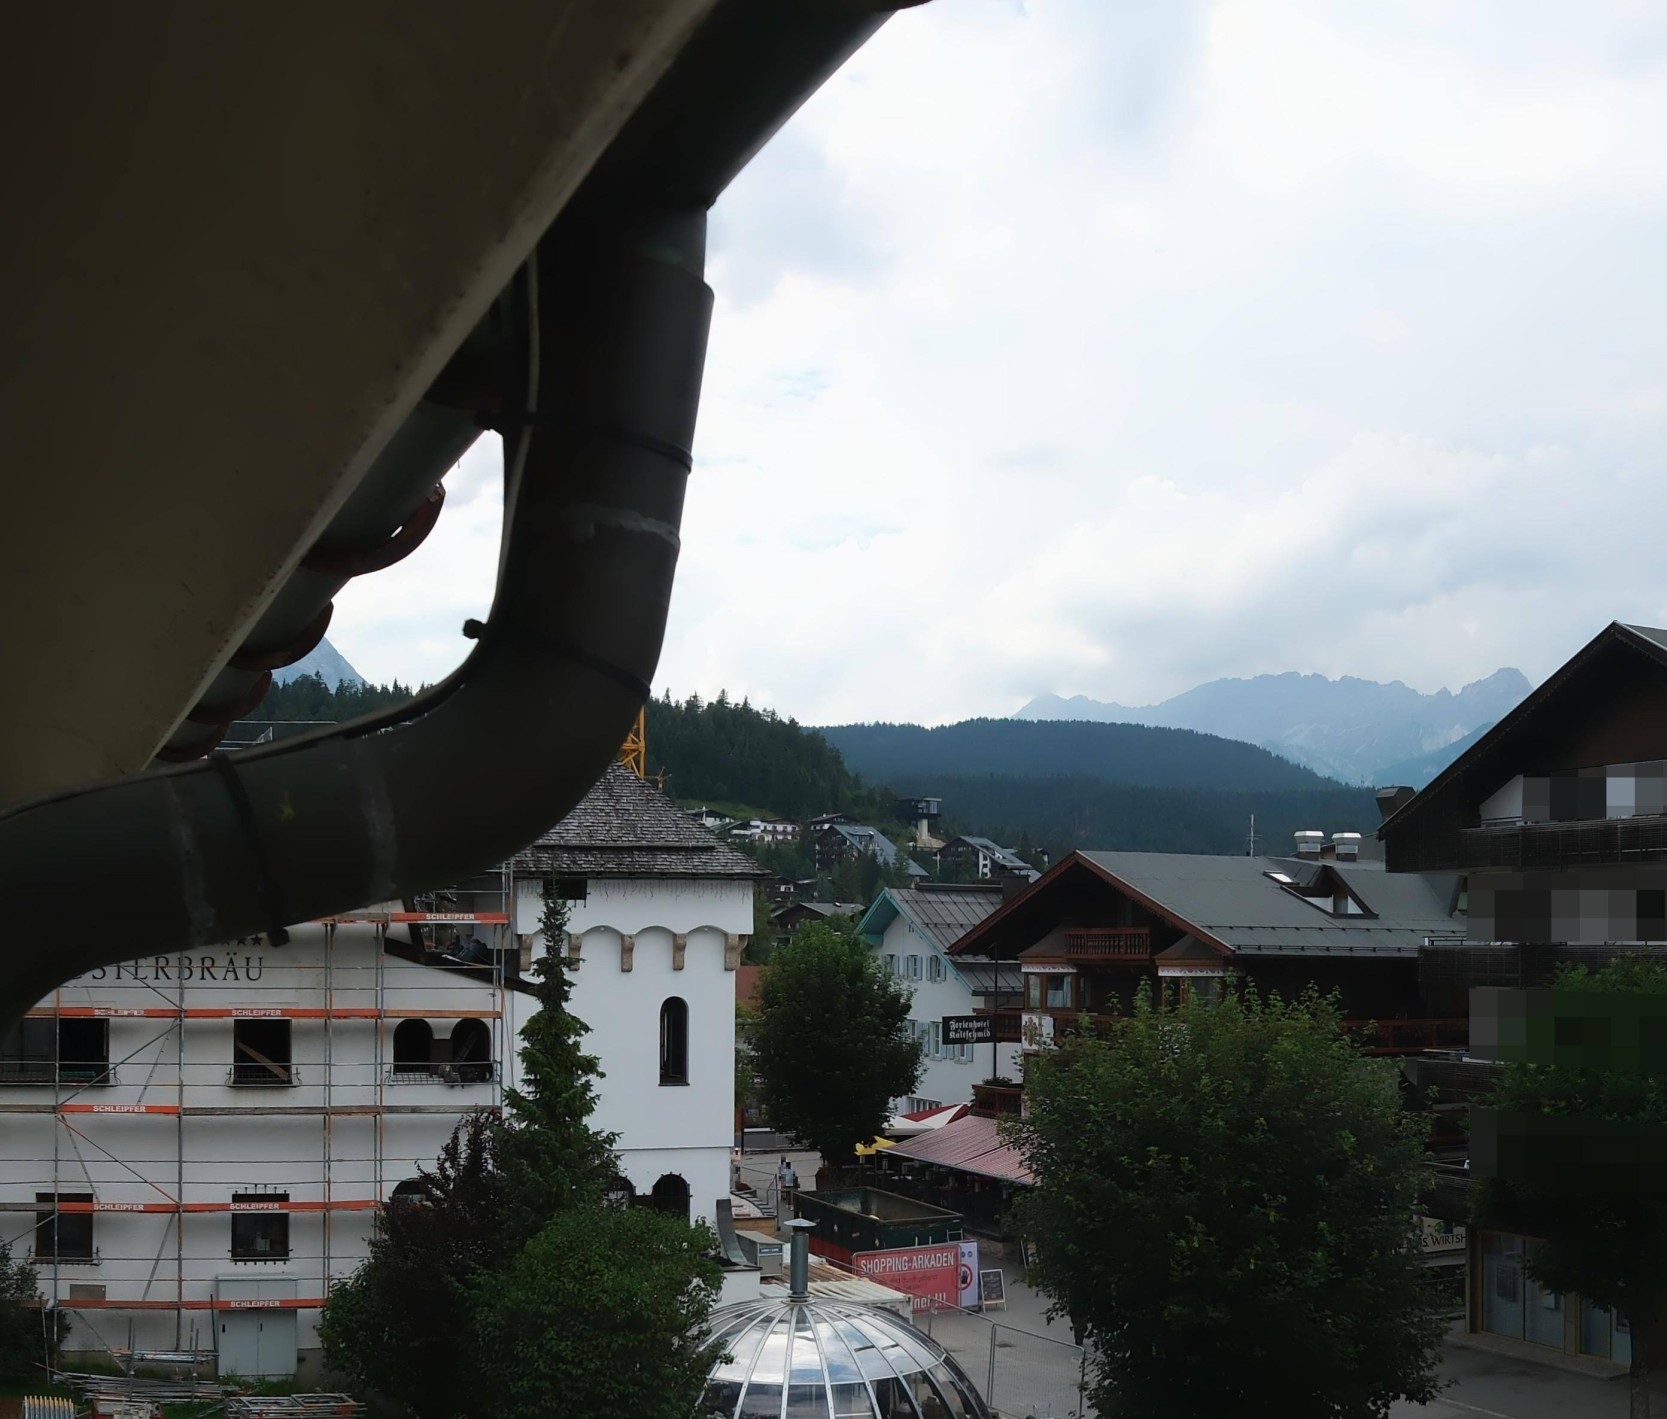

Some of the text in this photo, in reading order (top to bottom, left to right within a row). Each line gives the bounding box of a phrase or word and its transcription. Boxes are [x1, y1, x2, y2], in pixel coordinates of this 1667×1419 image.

[93, 1105, 146, 1113] SCHLEIPFER
[93, 1203, 144, 1211] SCHLEIPFER
[230, 1202, 280, 1210] SCHLEIPFER
[860, 1252, 954, 1275] SHOPPING-ARKADEN
